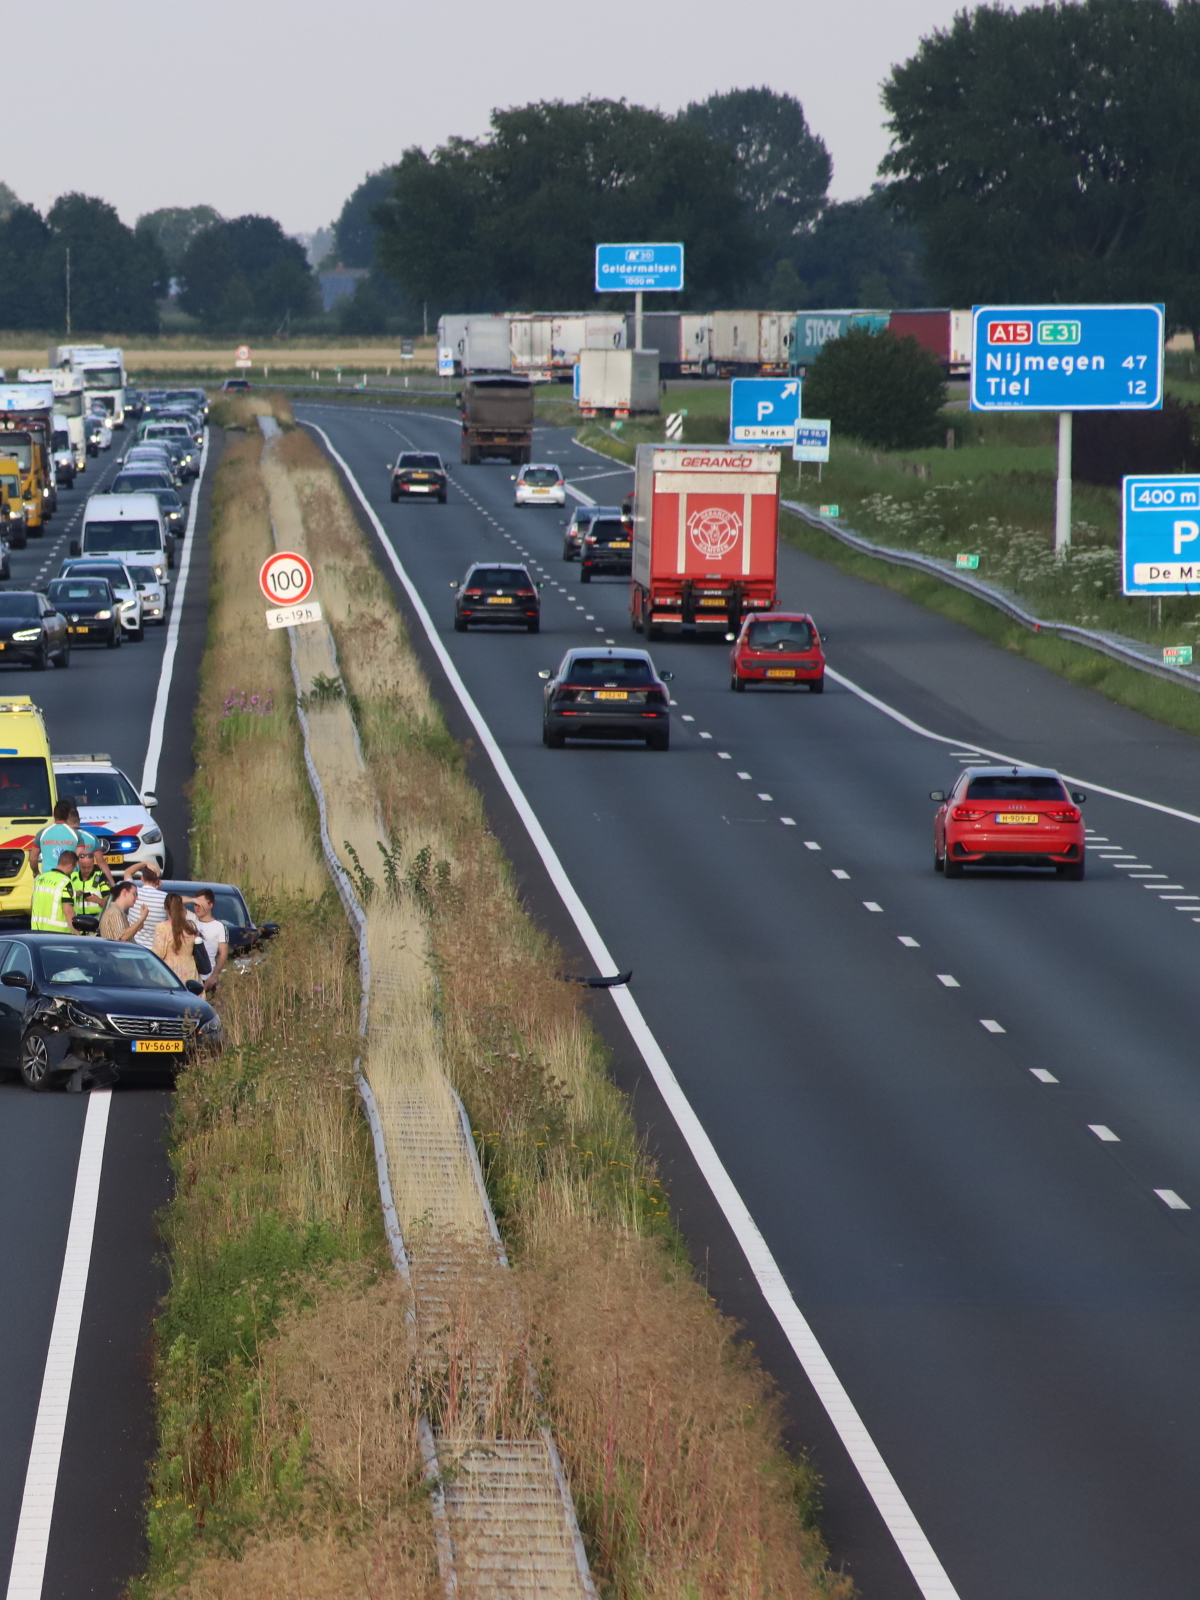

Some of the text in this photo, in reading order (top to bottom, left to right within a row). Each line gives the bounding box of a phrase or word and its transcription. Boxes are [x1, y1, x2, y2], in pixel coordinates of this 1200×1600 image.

[602, 263, 677, 273] Geldermalsen
[993, 325, 1029, 341] A15
[986, 352, 1148, 376] Nijmegen 47
[986, 377, 1147, 396] Tiel 12
[757, 401, 774, 421] P
[799, 429, 809, 437] FM
[681, 457, 752, 468] GERANCO
[1138, 489, 1197, 504] 400 m
[1173, 520, 1200, 554] P
[270, 568, 304, 593] 100
[1150, 567, 1171, 580] De
[1002, 815, 1036, 823] H-909-FJ
[139, 1042, 180, 1051] TV-566-R
